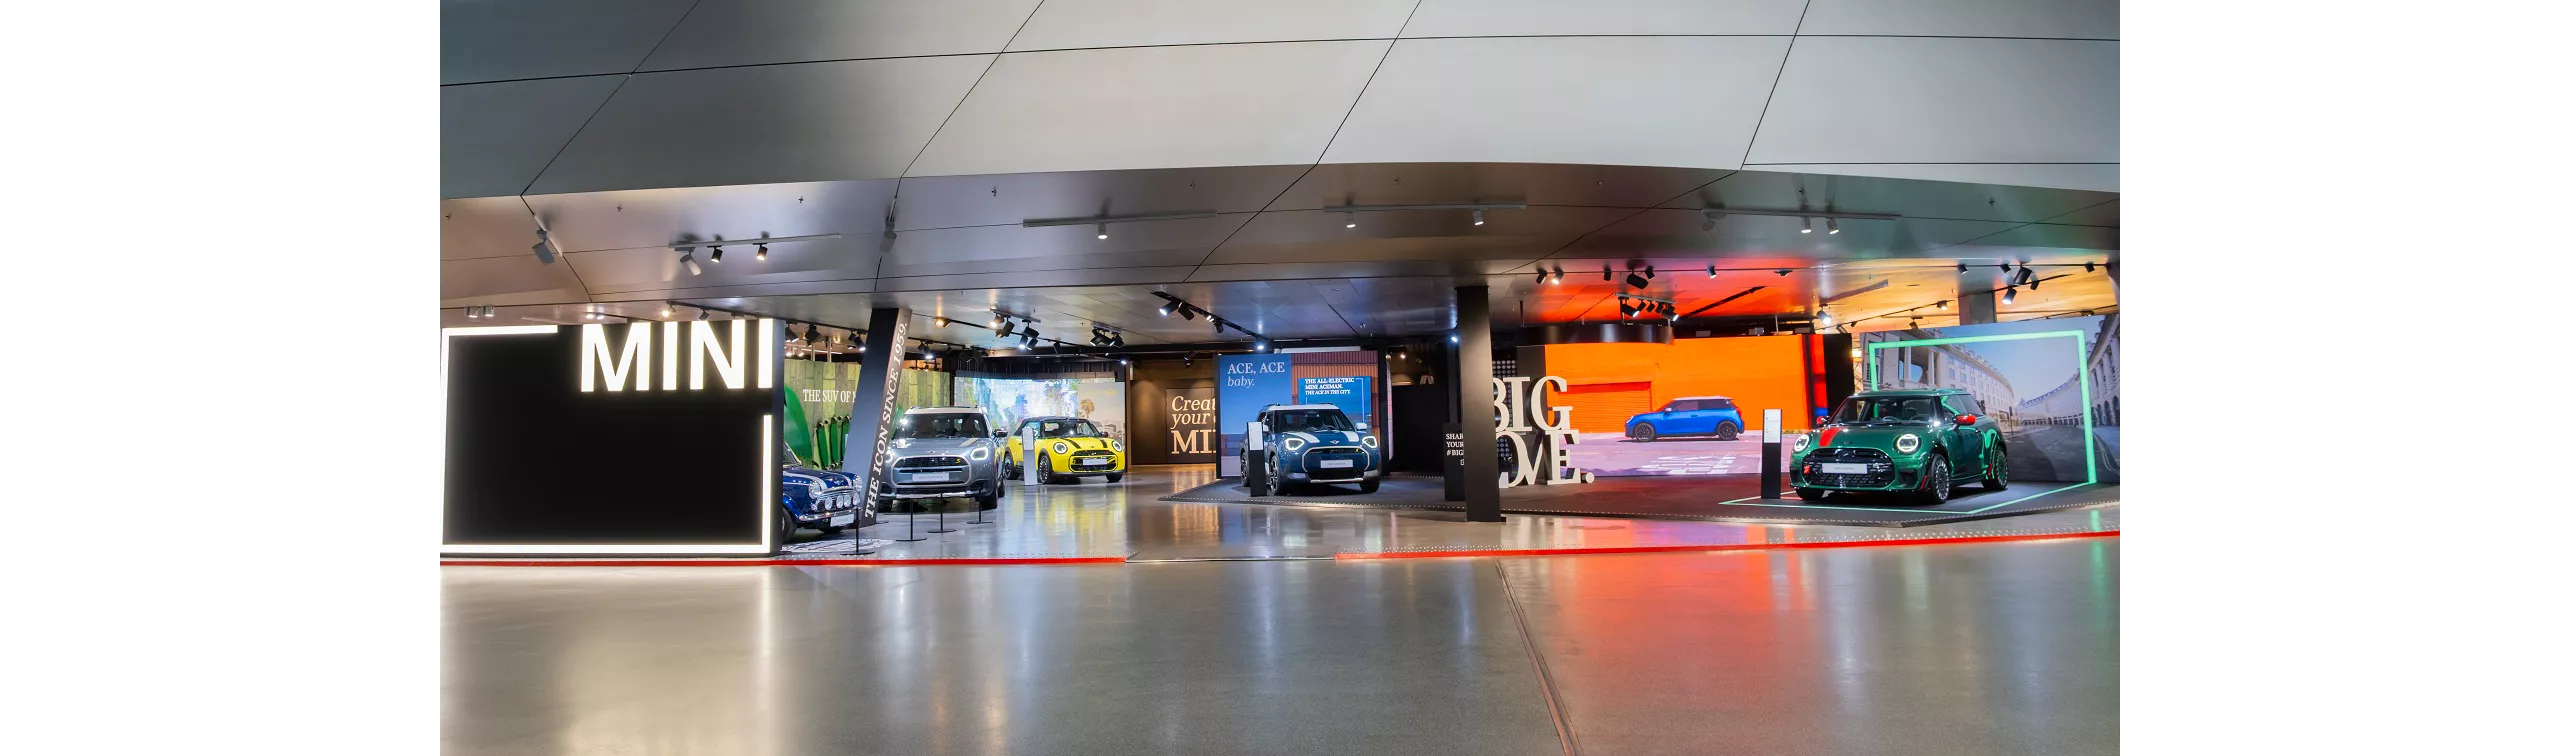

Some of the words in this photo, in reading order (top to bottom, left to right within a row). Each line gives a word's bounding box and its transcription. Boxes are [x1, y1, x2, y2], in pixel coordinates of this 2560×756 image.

[580, 318, 774, 392] MINI
[1227, 362, 1256, 375] ACE,
[1259, 361, 1285, 374] ACE
[1227, 376, 1255, 389] baby.
[802, 388, 821, 402] THE
[822, 389, 840, 403] SUV
[840, 390, 852, 403] OF
[865, 477, 879, 518] THE
[873, 425, 889, 475] ICON
[882, 368, 899, 424] SINCE
[893, 323, 908, 366] 1959.
[1170, 412, 1211, 430] your
[1171, 429, 1216, 454] MI
